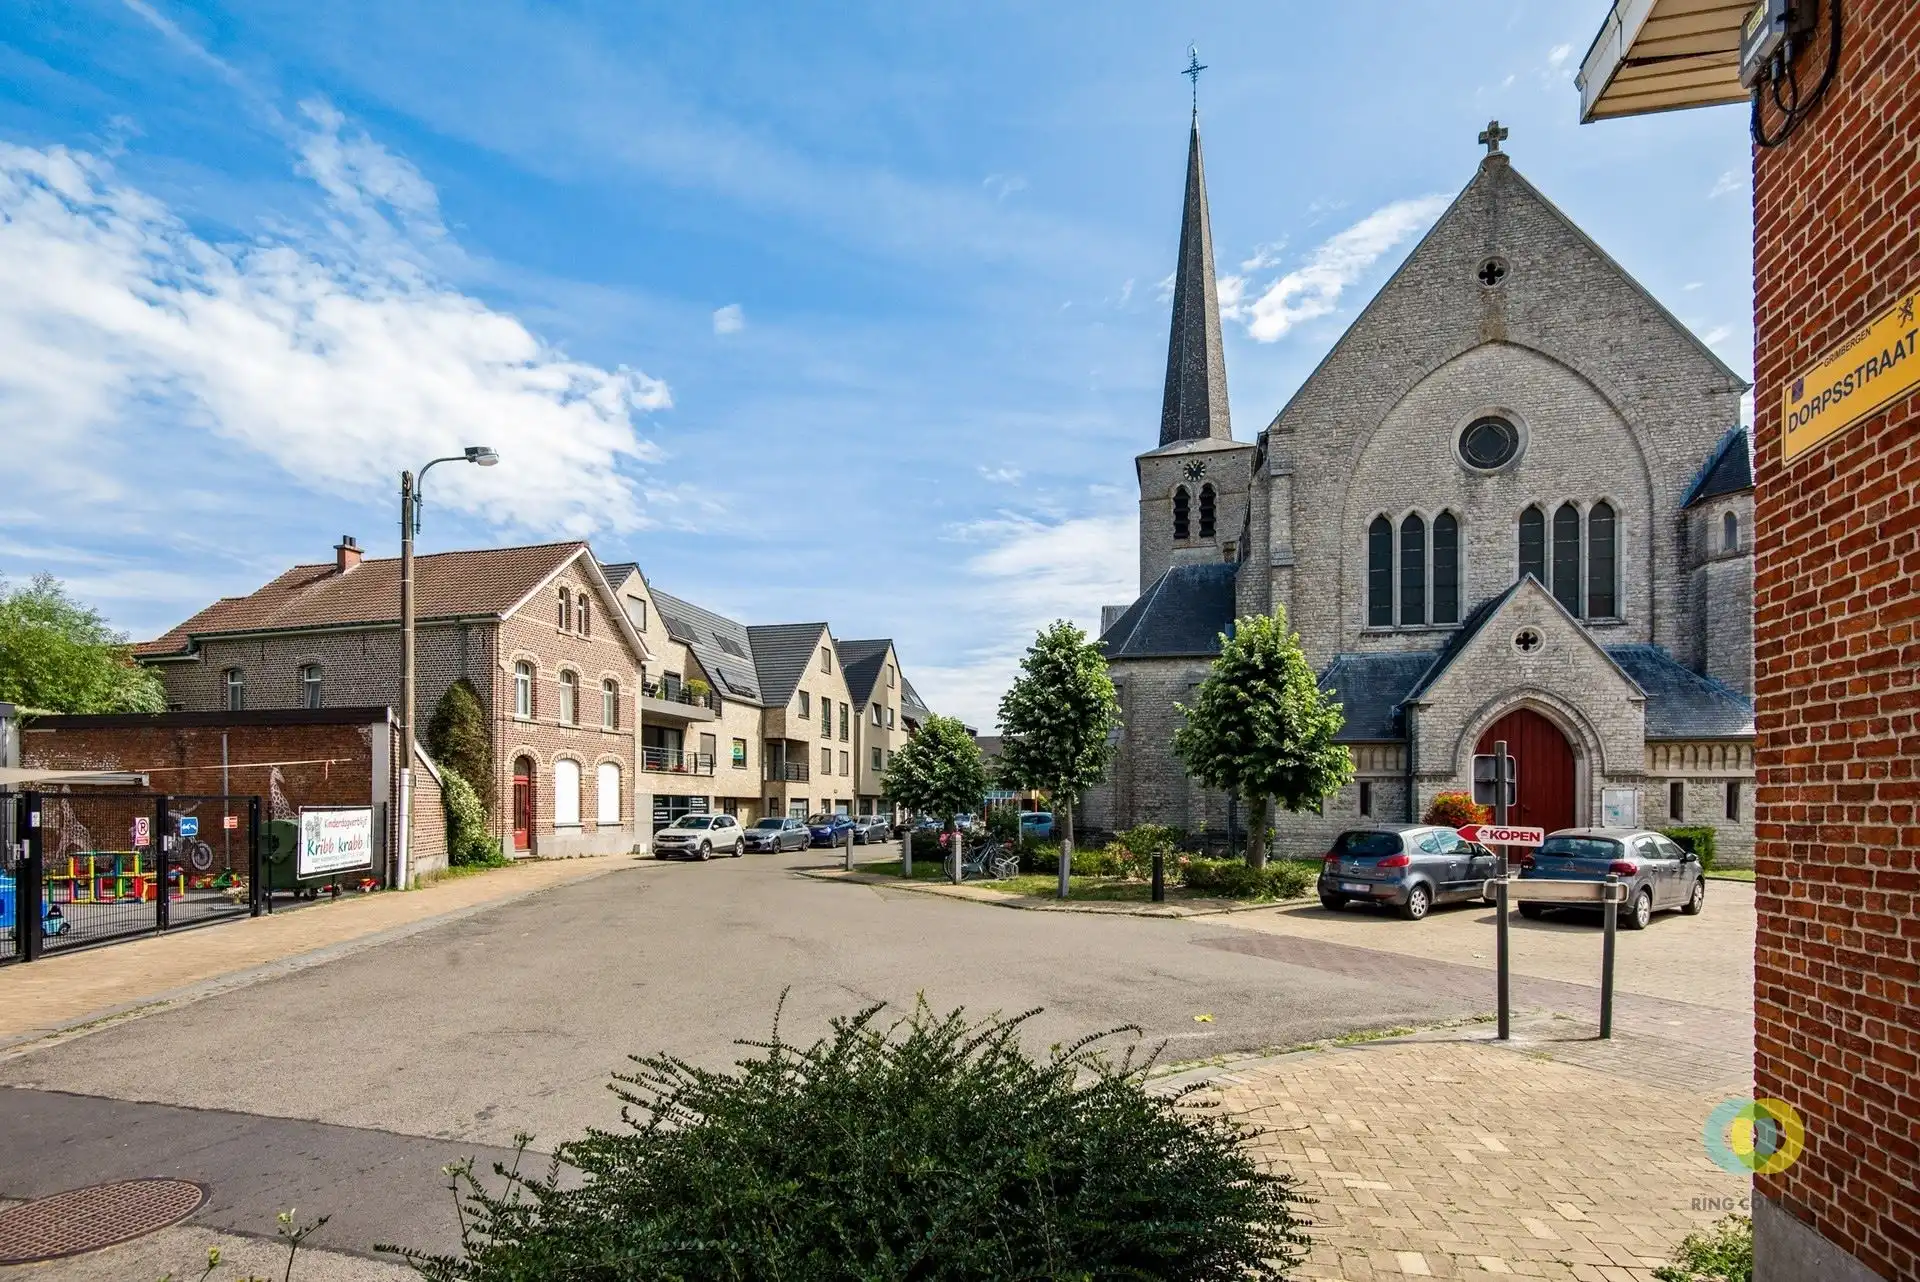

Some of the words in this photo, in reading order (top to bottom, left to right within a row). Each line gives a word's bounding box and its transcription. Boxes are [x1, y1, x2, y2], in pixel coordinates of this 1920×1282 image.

[1823, 327, 1872, 367] GRIMBERGEN
[1788, 328, 1919, 433] DORPSSTRAAT
[1490, 830, 1541, 842] KOPEN
